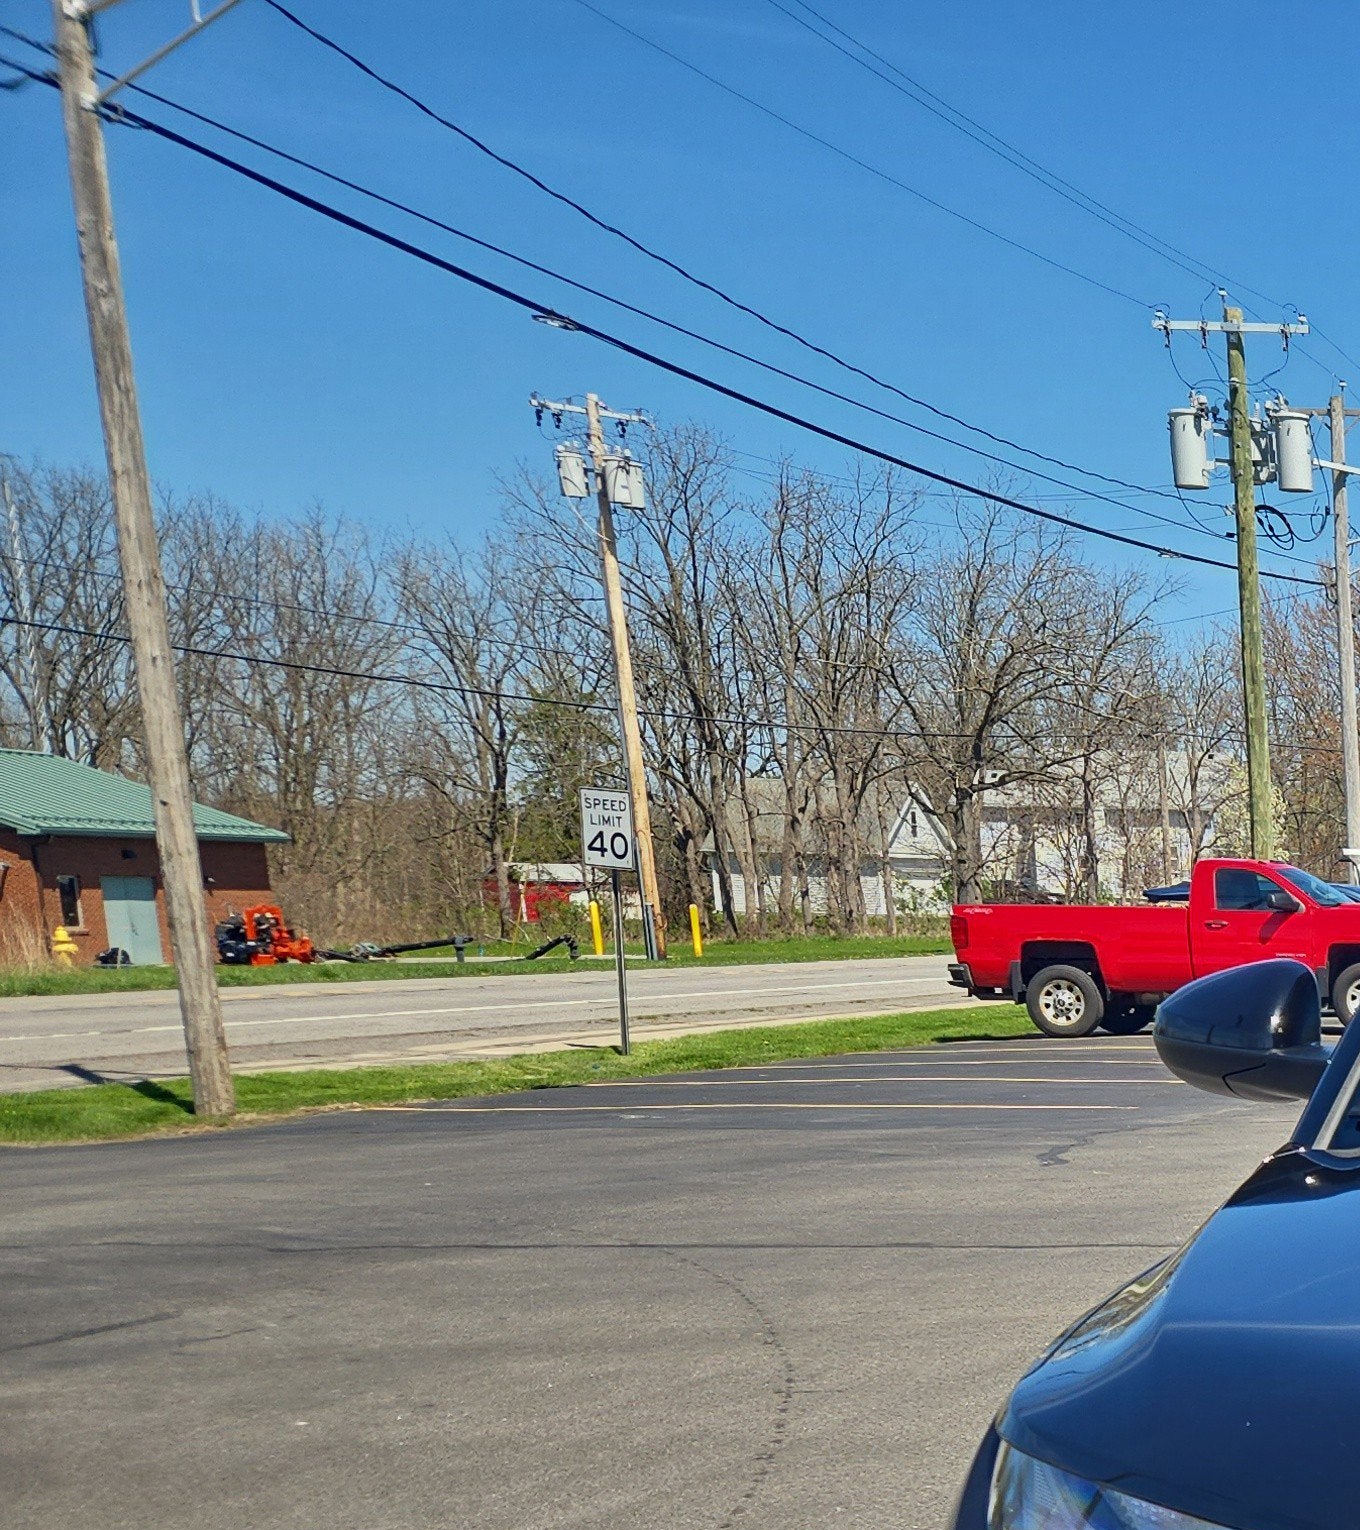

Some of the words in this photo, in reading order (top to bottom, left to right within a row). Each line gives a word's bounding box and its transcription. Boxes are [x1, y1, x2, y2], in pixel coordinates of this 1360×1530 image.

[584, 797, 627, 812] SPEED
[589, 813, 623, 828] LIMIT
[587, 830, 629, 860] 40
